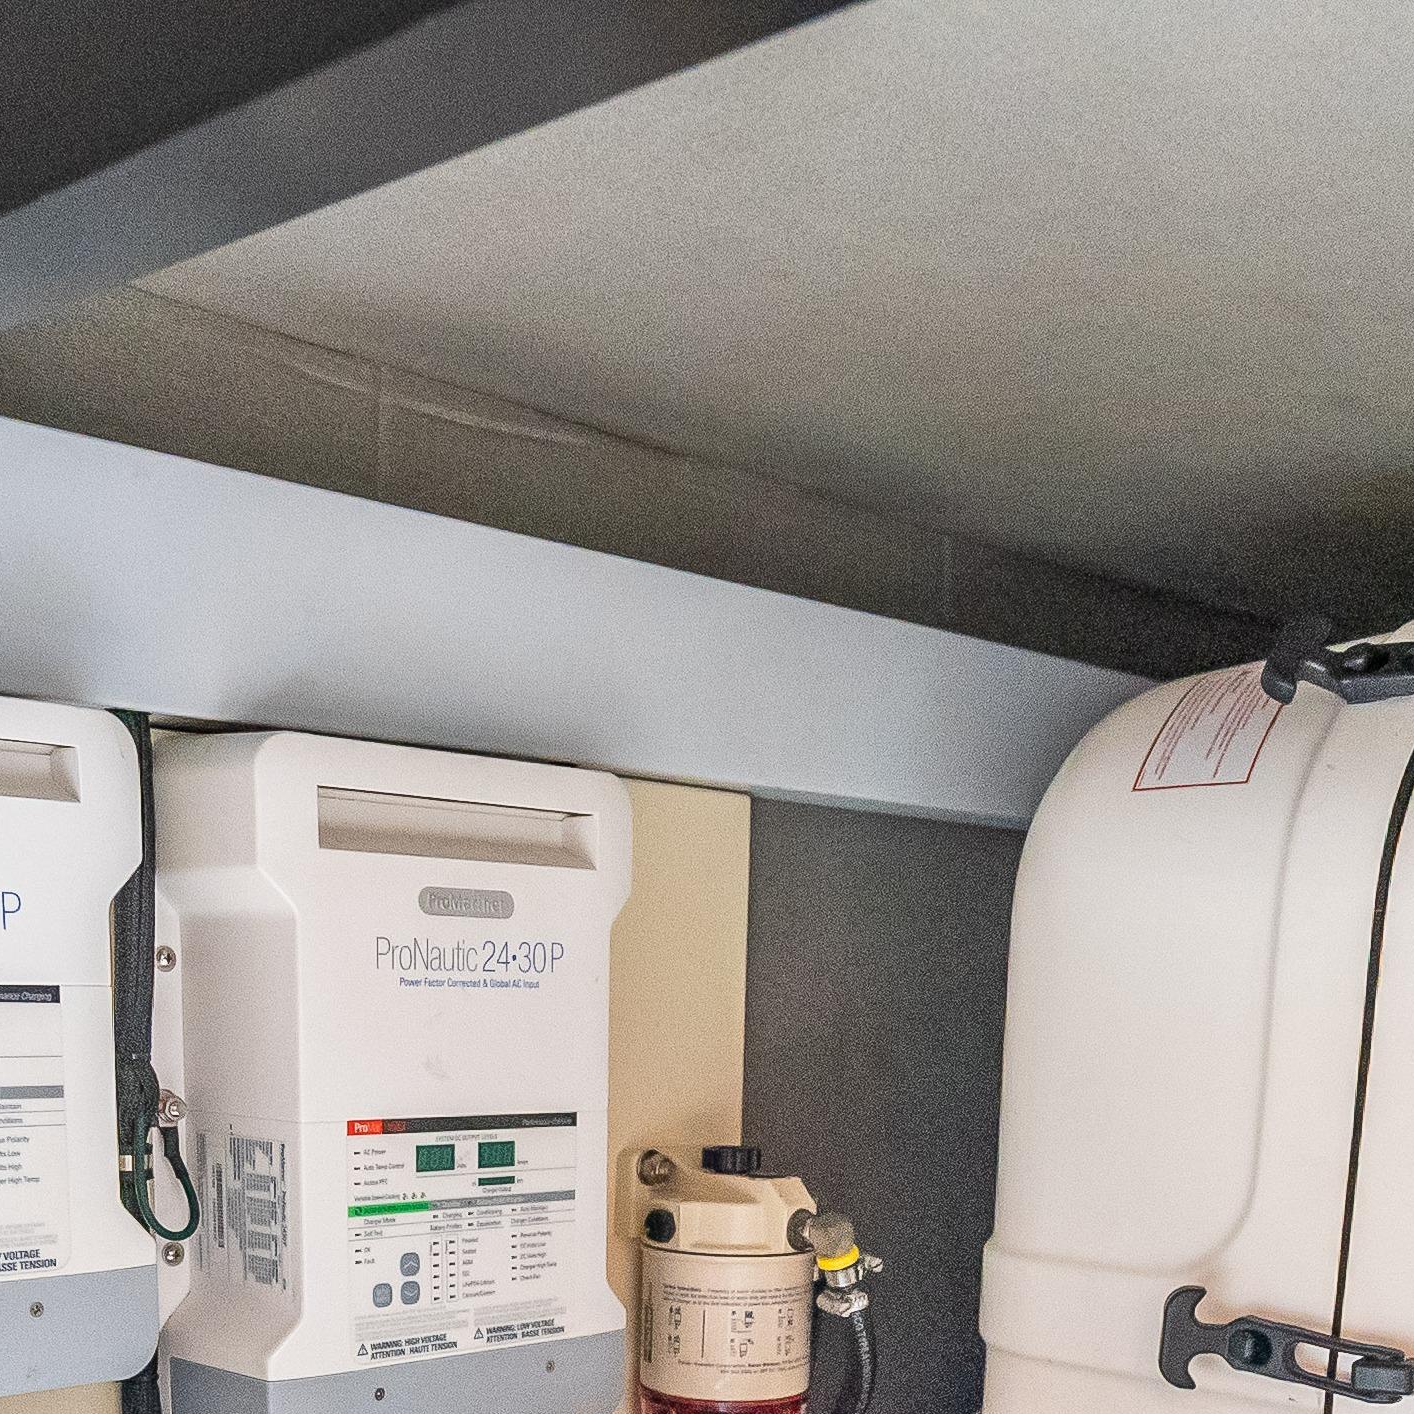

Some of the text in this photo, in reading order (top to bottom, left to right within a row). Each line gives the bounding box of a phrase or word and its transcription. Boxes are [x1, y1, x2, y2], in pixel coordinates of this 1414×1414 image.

[376, 937, 478, 972] ProNautic
[399, 977, 422, 987] Power
[424, 977, 445, 987] Factor
[447, 978, 481, 988] Corrected
[489, 979, 511, 988] Global
[3, 1249, 41, 1261] VOLTAGE
[20, 1258, 57, 1270] TENSION
